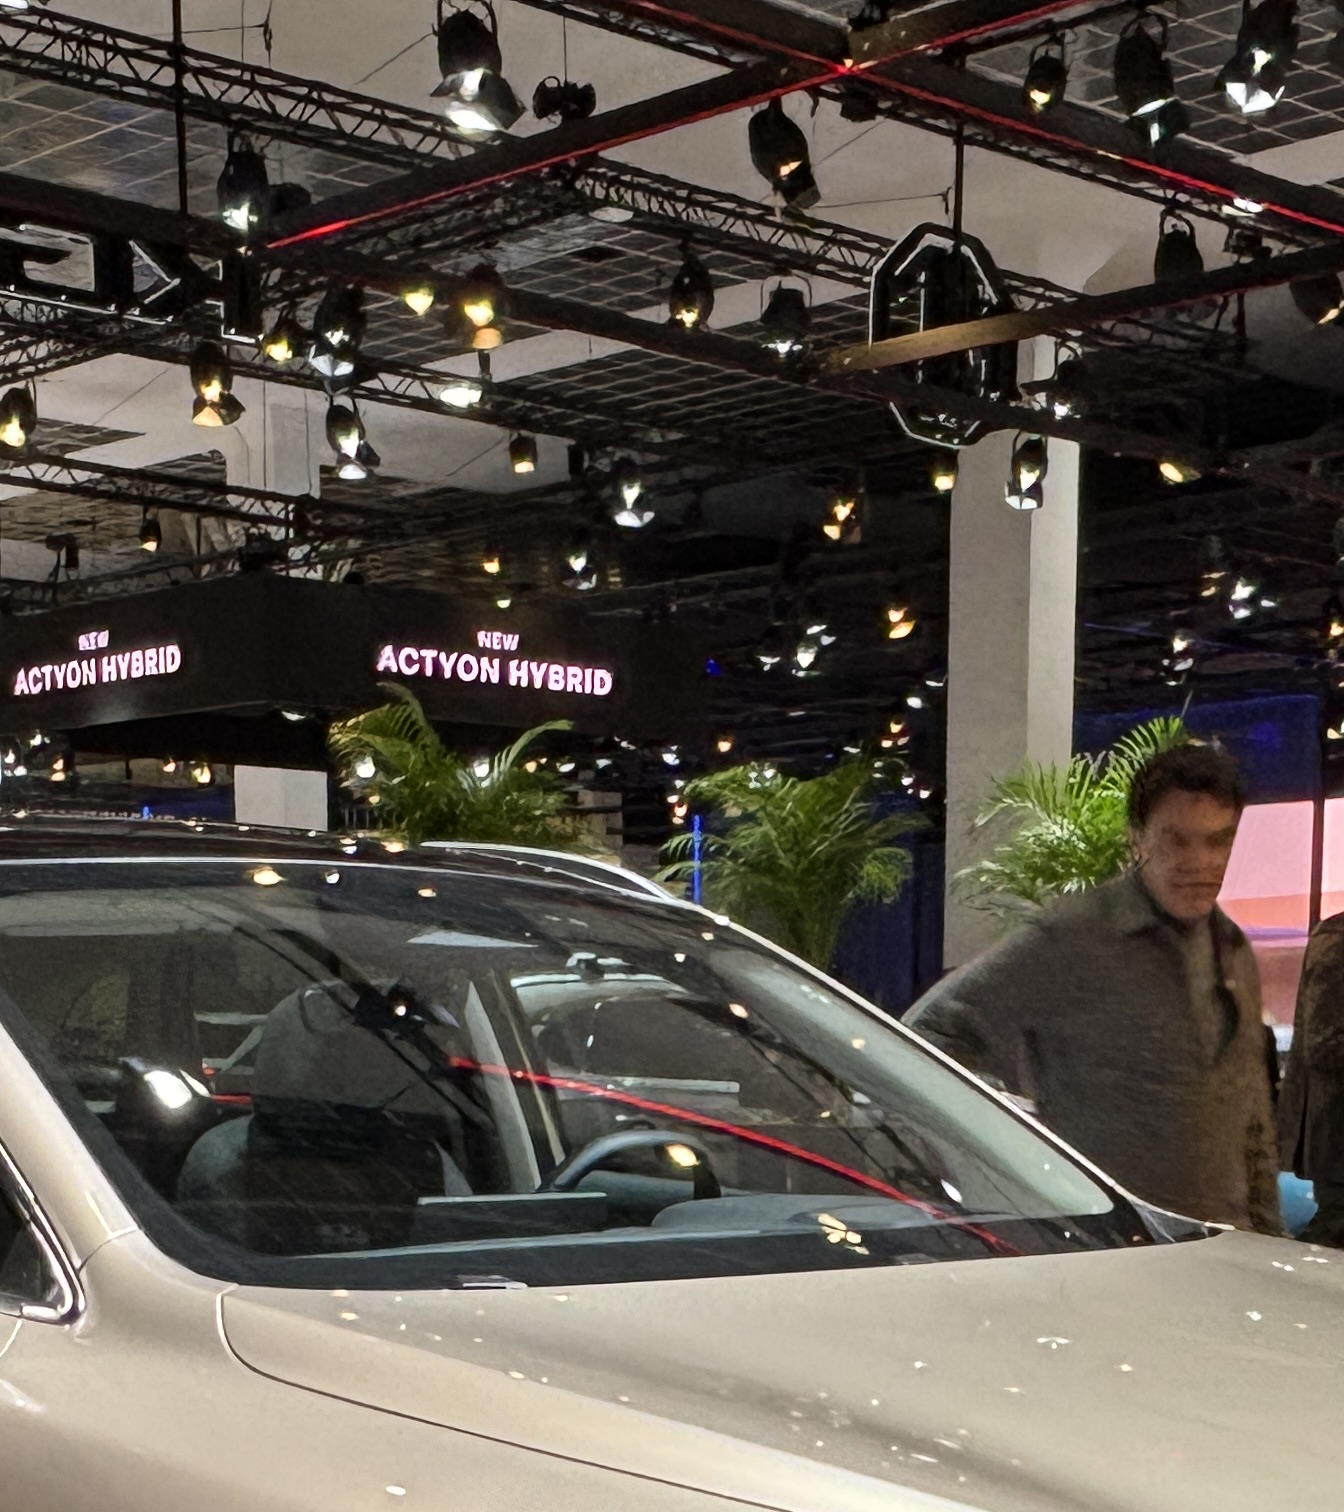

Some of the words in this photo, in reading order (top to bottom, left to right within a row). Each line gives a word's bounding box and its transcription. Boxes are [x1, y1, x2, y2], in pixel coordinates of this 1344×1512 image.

[477, 630, 520, 651] NEW
[13, 658, 97, 696] ACTYON
[101, 644, 182, 683] HYBRID
[376, 644, 500, 684] ACTYON
[508, 659, 613, 696] HYBRID
